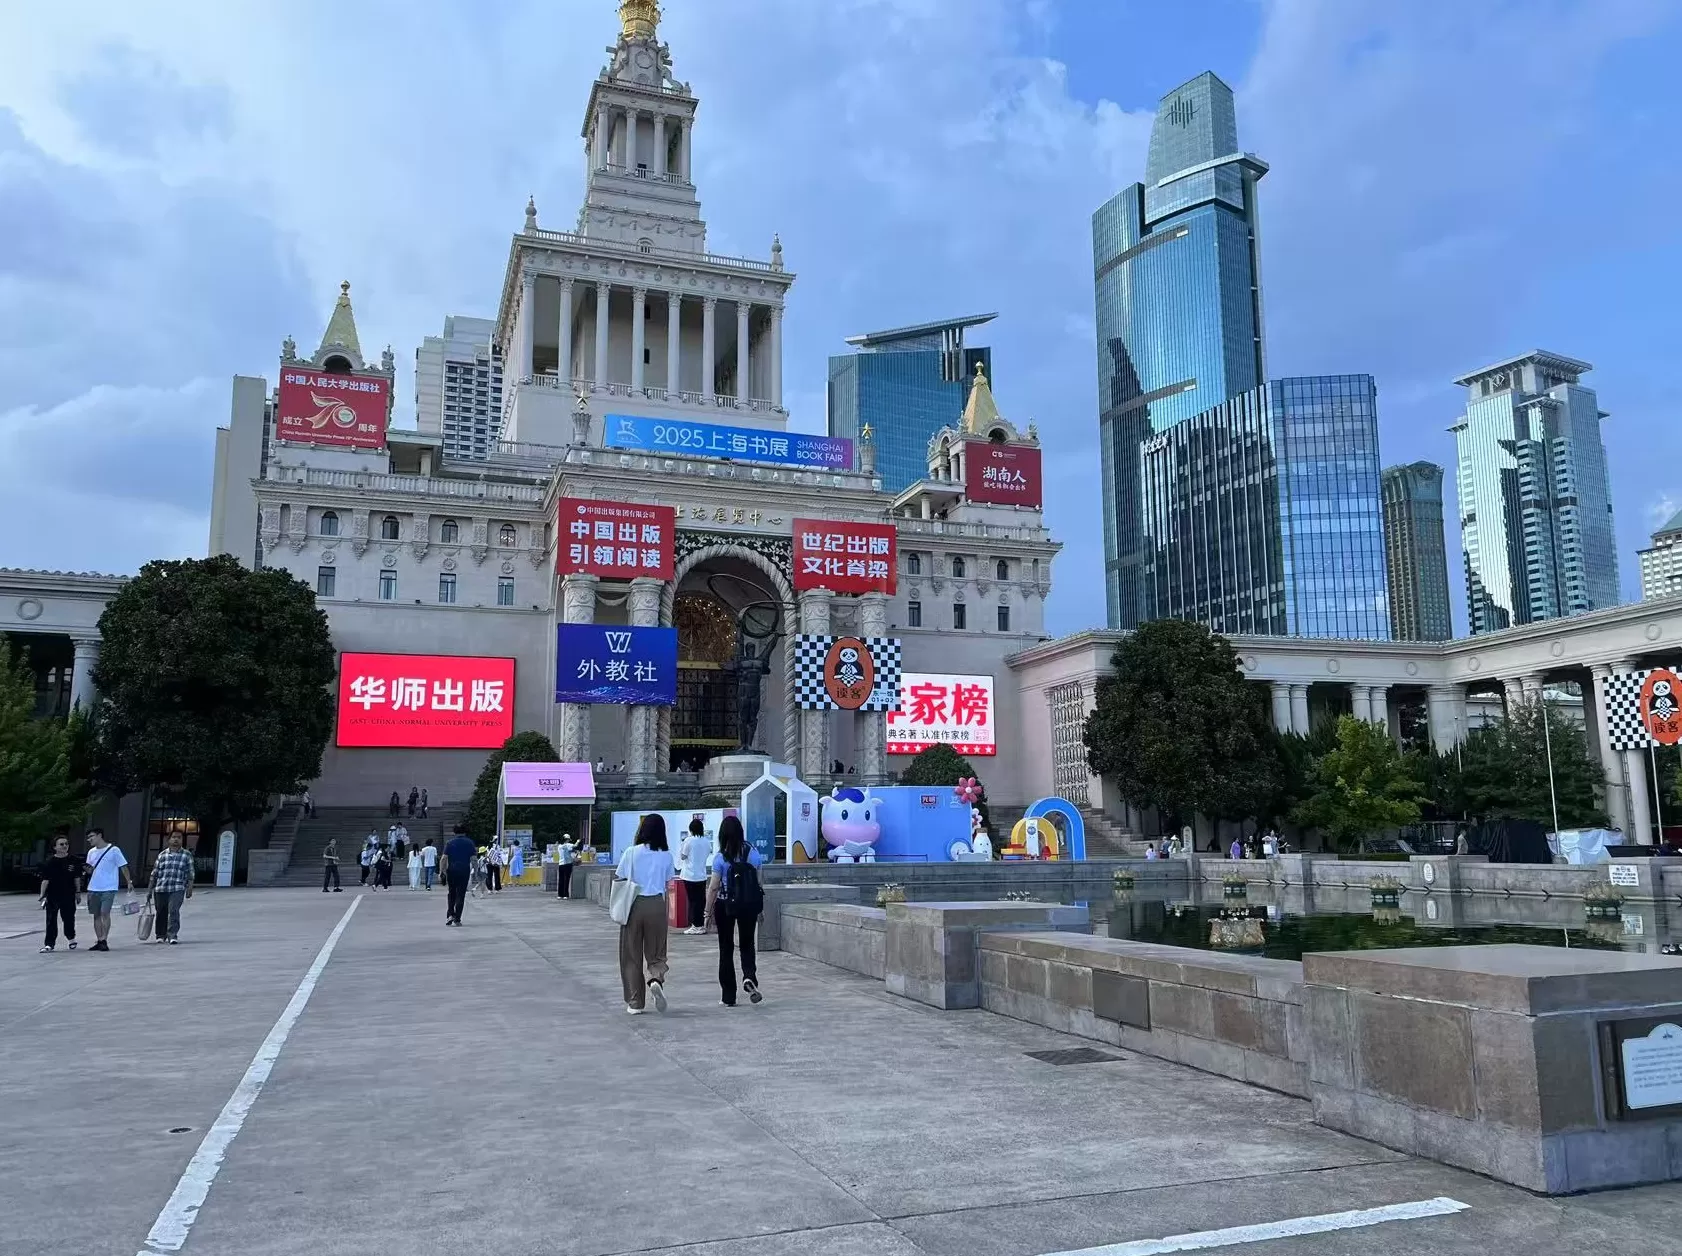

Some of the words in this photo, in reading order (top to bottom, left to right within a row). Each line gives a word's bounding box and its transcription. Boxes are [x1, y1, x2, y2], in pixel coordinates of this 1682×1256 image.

[285, 373, 380, 393] 中国人民大学出版社
[283, 416, 303, 426] 成立
[357, 423, 378, 433] 周年
[653, 424, 789, 458] 2025上海书展
[797, 440, 844, 453] SHANGHAI
[797, 450, 823, 462] BOOK
[823, 452, 844, 463] FAIR
[982, 466, 1027, 483] 湖南人
[587, 506, 656, 520] 中国出版集团有限公司
[570, 519, 661, 544] 中国出版
[801, 532, 889, 555] 世纪出版
[570, 543, 661, 569] 引领阅读
[802, 556, 888, 579] 文化脊梁
[577, 658, 658, 682] 外教社
[349, 675, 504, 713] 华师出版
[921, 729, 970, 741] 认准作家榜
[1654, 721, 1679, 734] 读客
